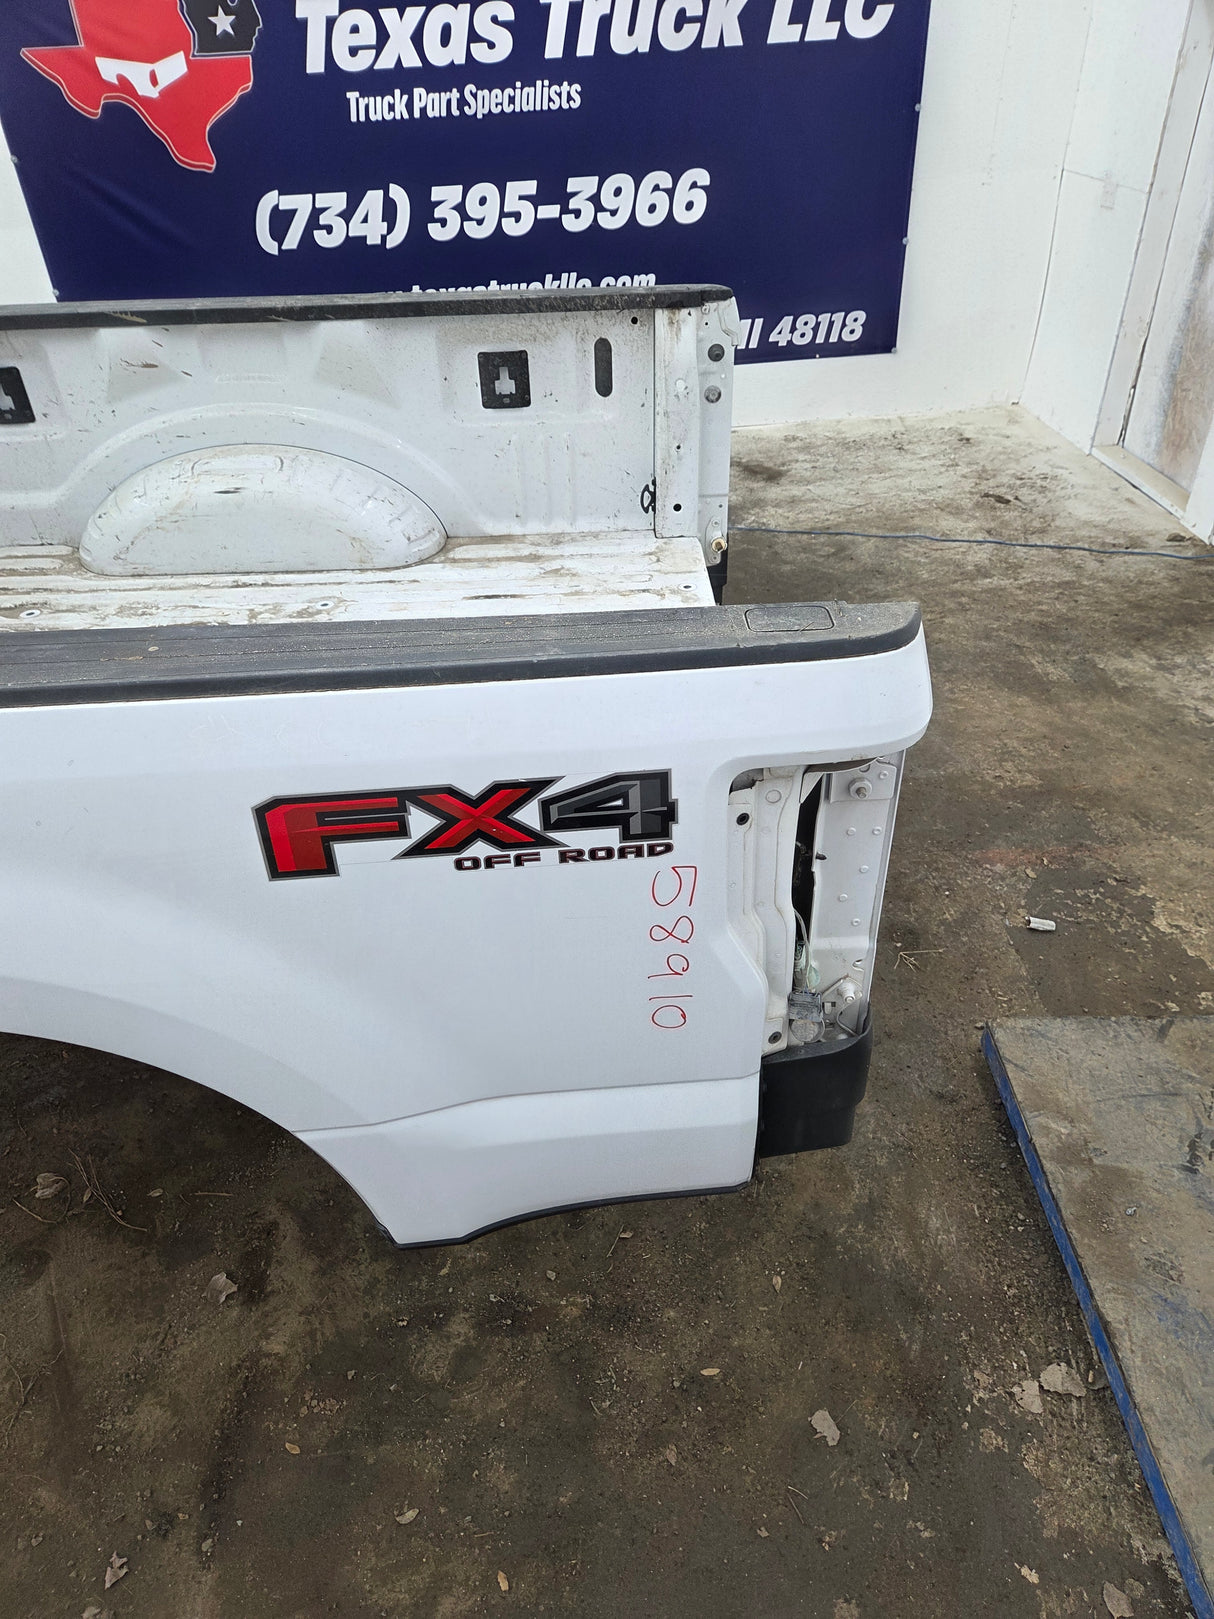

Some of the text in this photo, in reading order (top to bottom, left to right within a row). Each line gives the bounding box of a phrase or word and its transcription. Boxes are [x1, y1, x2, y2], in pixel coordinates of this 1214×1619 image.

[295, 0, 895, 74] Texas Truck LLC
[346, 79, 582, 123] Truck Part Specialists
[254, 167, 711, 255] (734) 395-3966
[768, 310, 867, 347] 48118
[251, 768, 679, 882] FX4
[453, 841, 674, 872] OFF ROAD
[647, 865, 699, 1030] 58910
